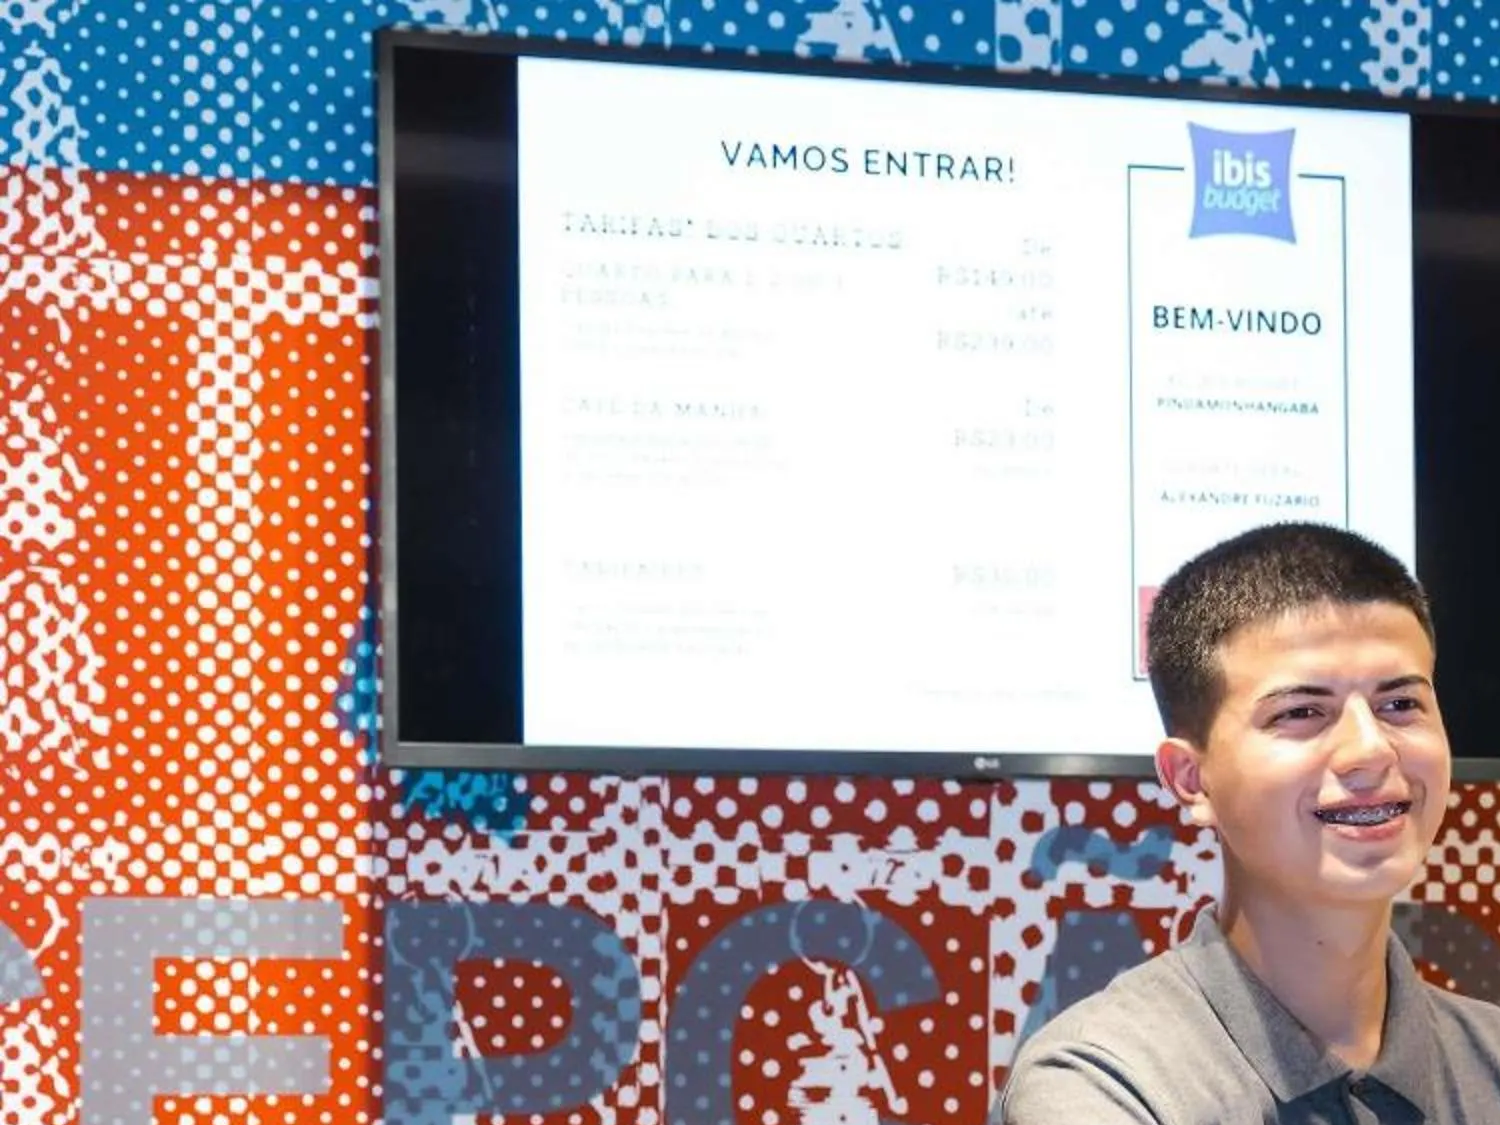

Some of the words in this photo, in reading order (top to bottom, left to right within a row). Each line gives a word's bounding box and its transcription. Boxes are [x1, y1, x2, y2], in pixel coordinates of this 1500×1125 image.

[721, 140, 849, 173] VAMOS
[864, 148, 1016, 183] ENTRAR!
[1212, 150, 1273, 188] ibis
[1202, 186, 1282, 217] budget
[1152, 304, 1324, 337] BEM-VINDO
